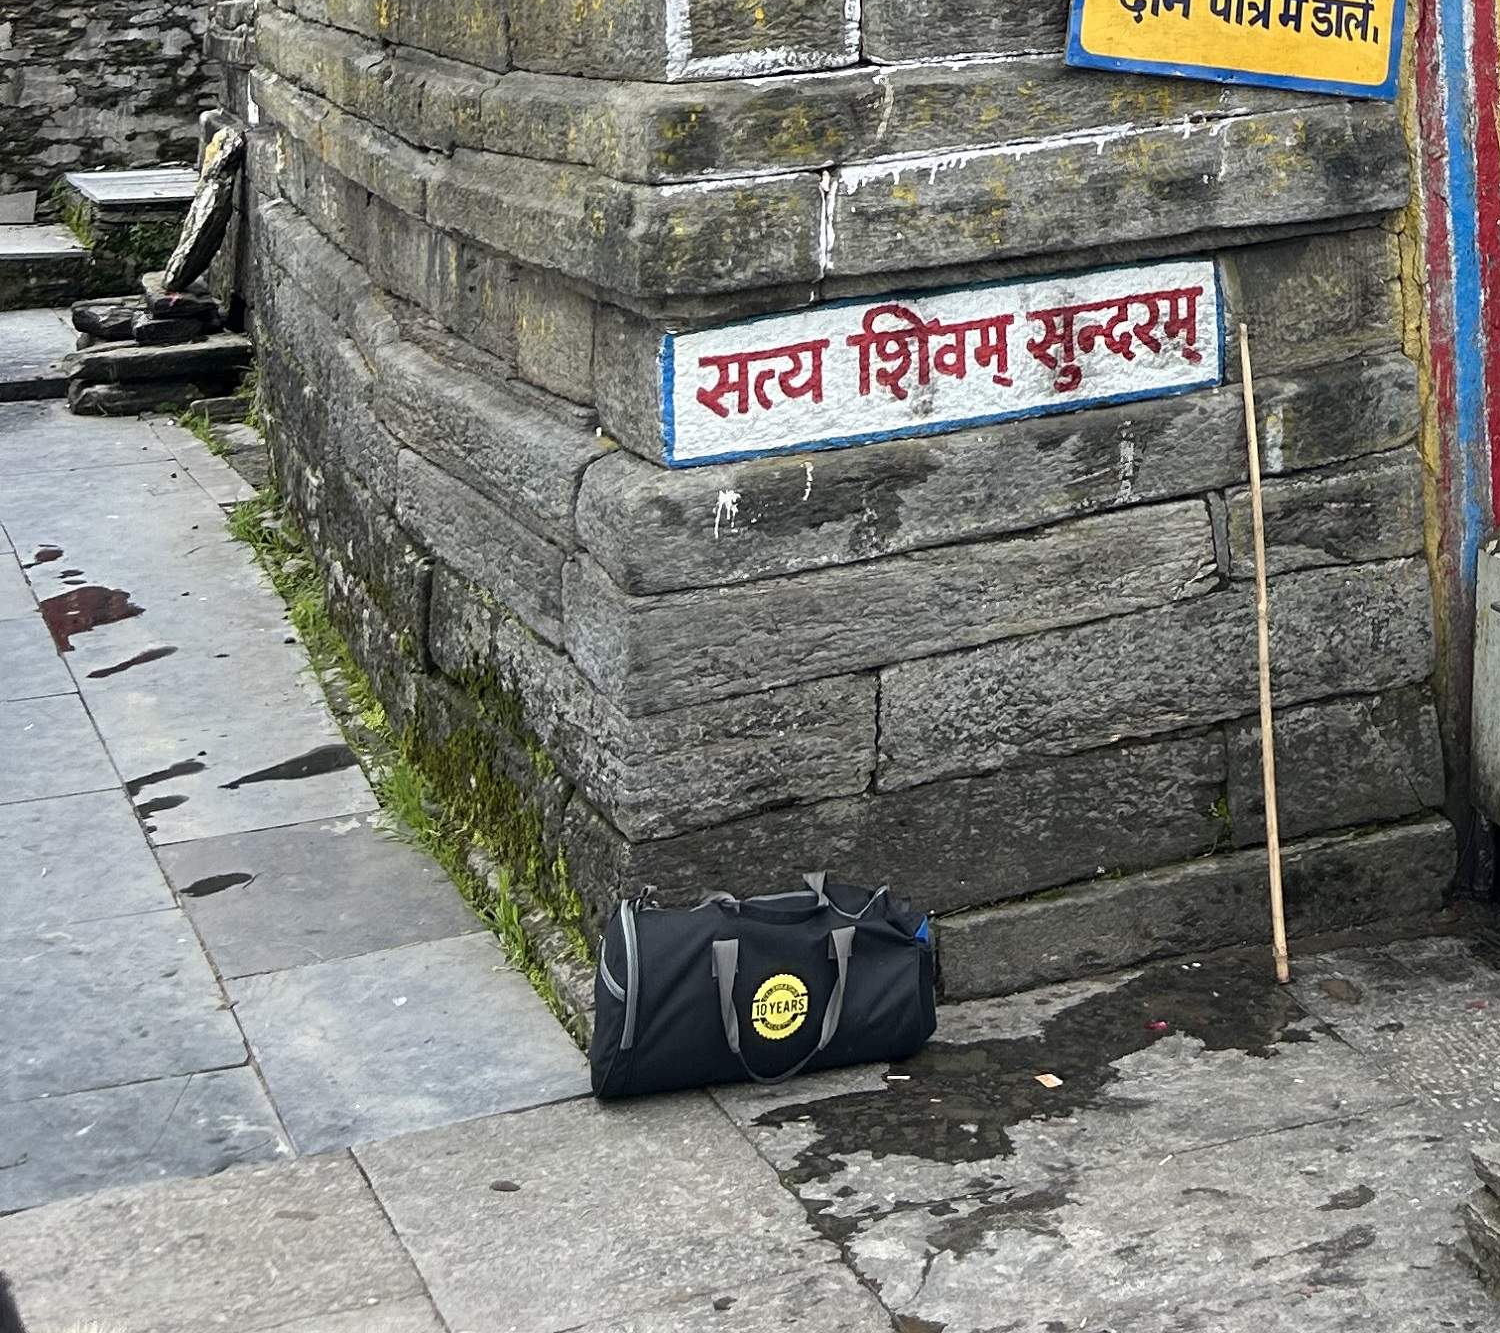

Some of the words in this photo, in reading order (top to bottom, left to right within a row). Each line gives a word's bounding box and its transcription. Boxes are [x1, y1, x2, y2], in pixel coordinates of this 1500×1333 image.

[696, 338, 830, 419] सत्य
[847, 304, 1015, 400] शिवम्
[1026, 285, 1203, 393] सुन्दरम्
[756, 1003, 768, 1017] 10
[769, 998, 805, 1016] YEARS
